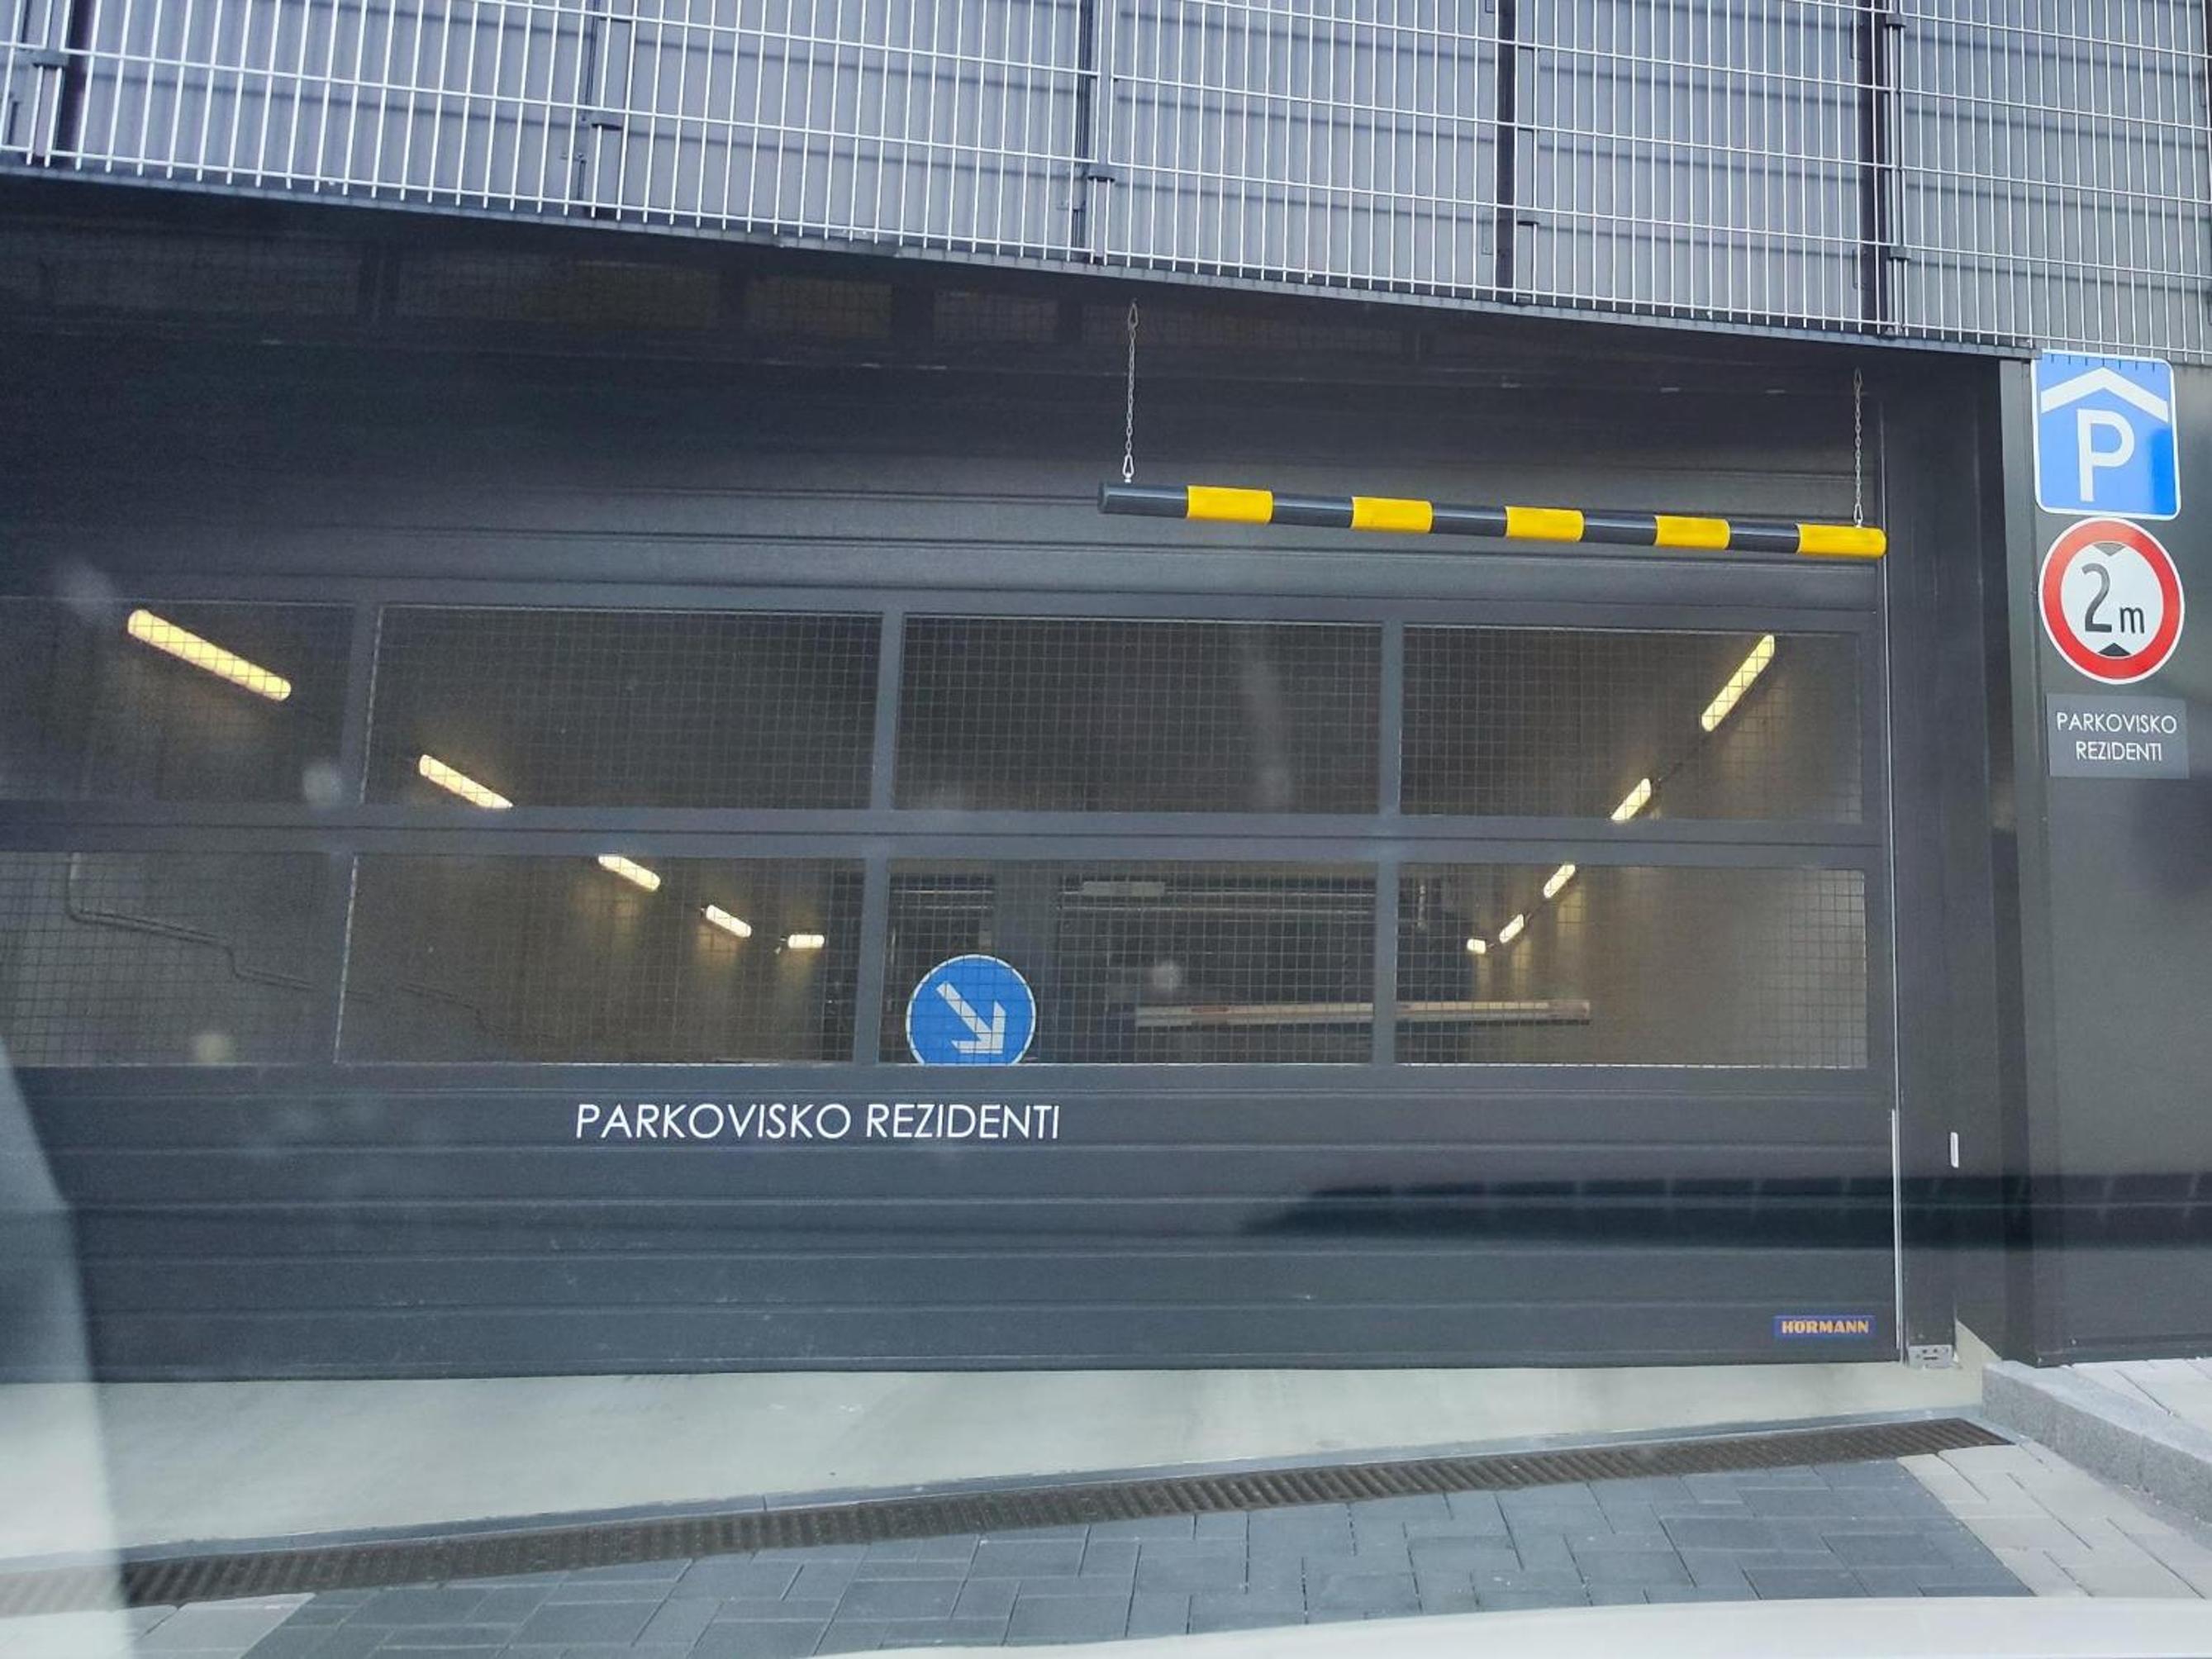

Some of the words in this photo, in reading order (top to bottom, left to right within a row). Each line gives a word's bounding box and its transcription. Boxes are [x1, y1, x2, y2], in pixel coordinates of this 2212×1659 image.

[2076, 408, 2135, 502] P
[2081, 563, 2112, 633] 2
[2119, 606, 2145, 634] m
[2056, 713, 2177, 734] PARKOVISKO
[2076, 741, 2162, 761] REZIDENTI
[576, 1104, 851, 1139] PARKOVISKO
[865, 1104, 1060, 1139] REZIDENTI
